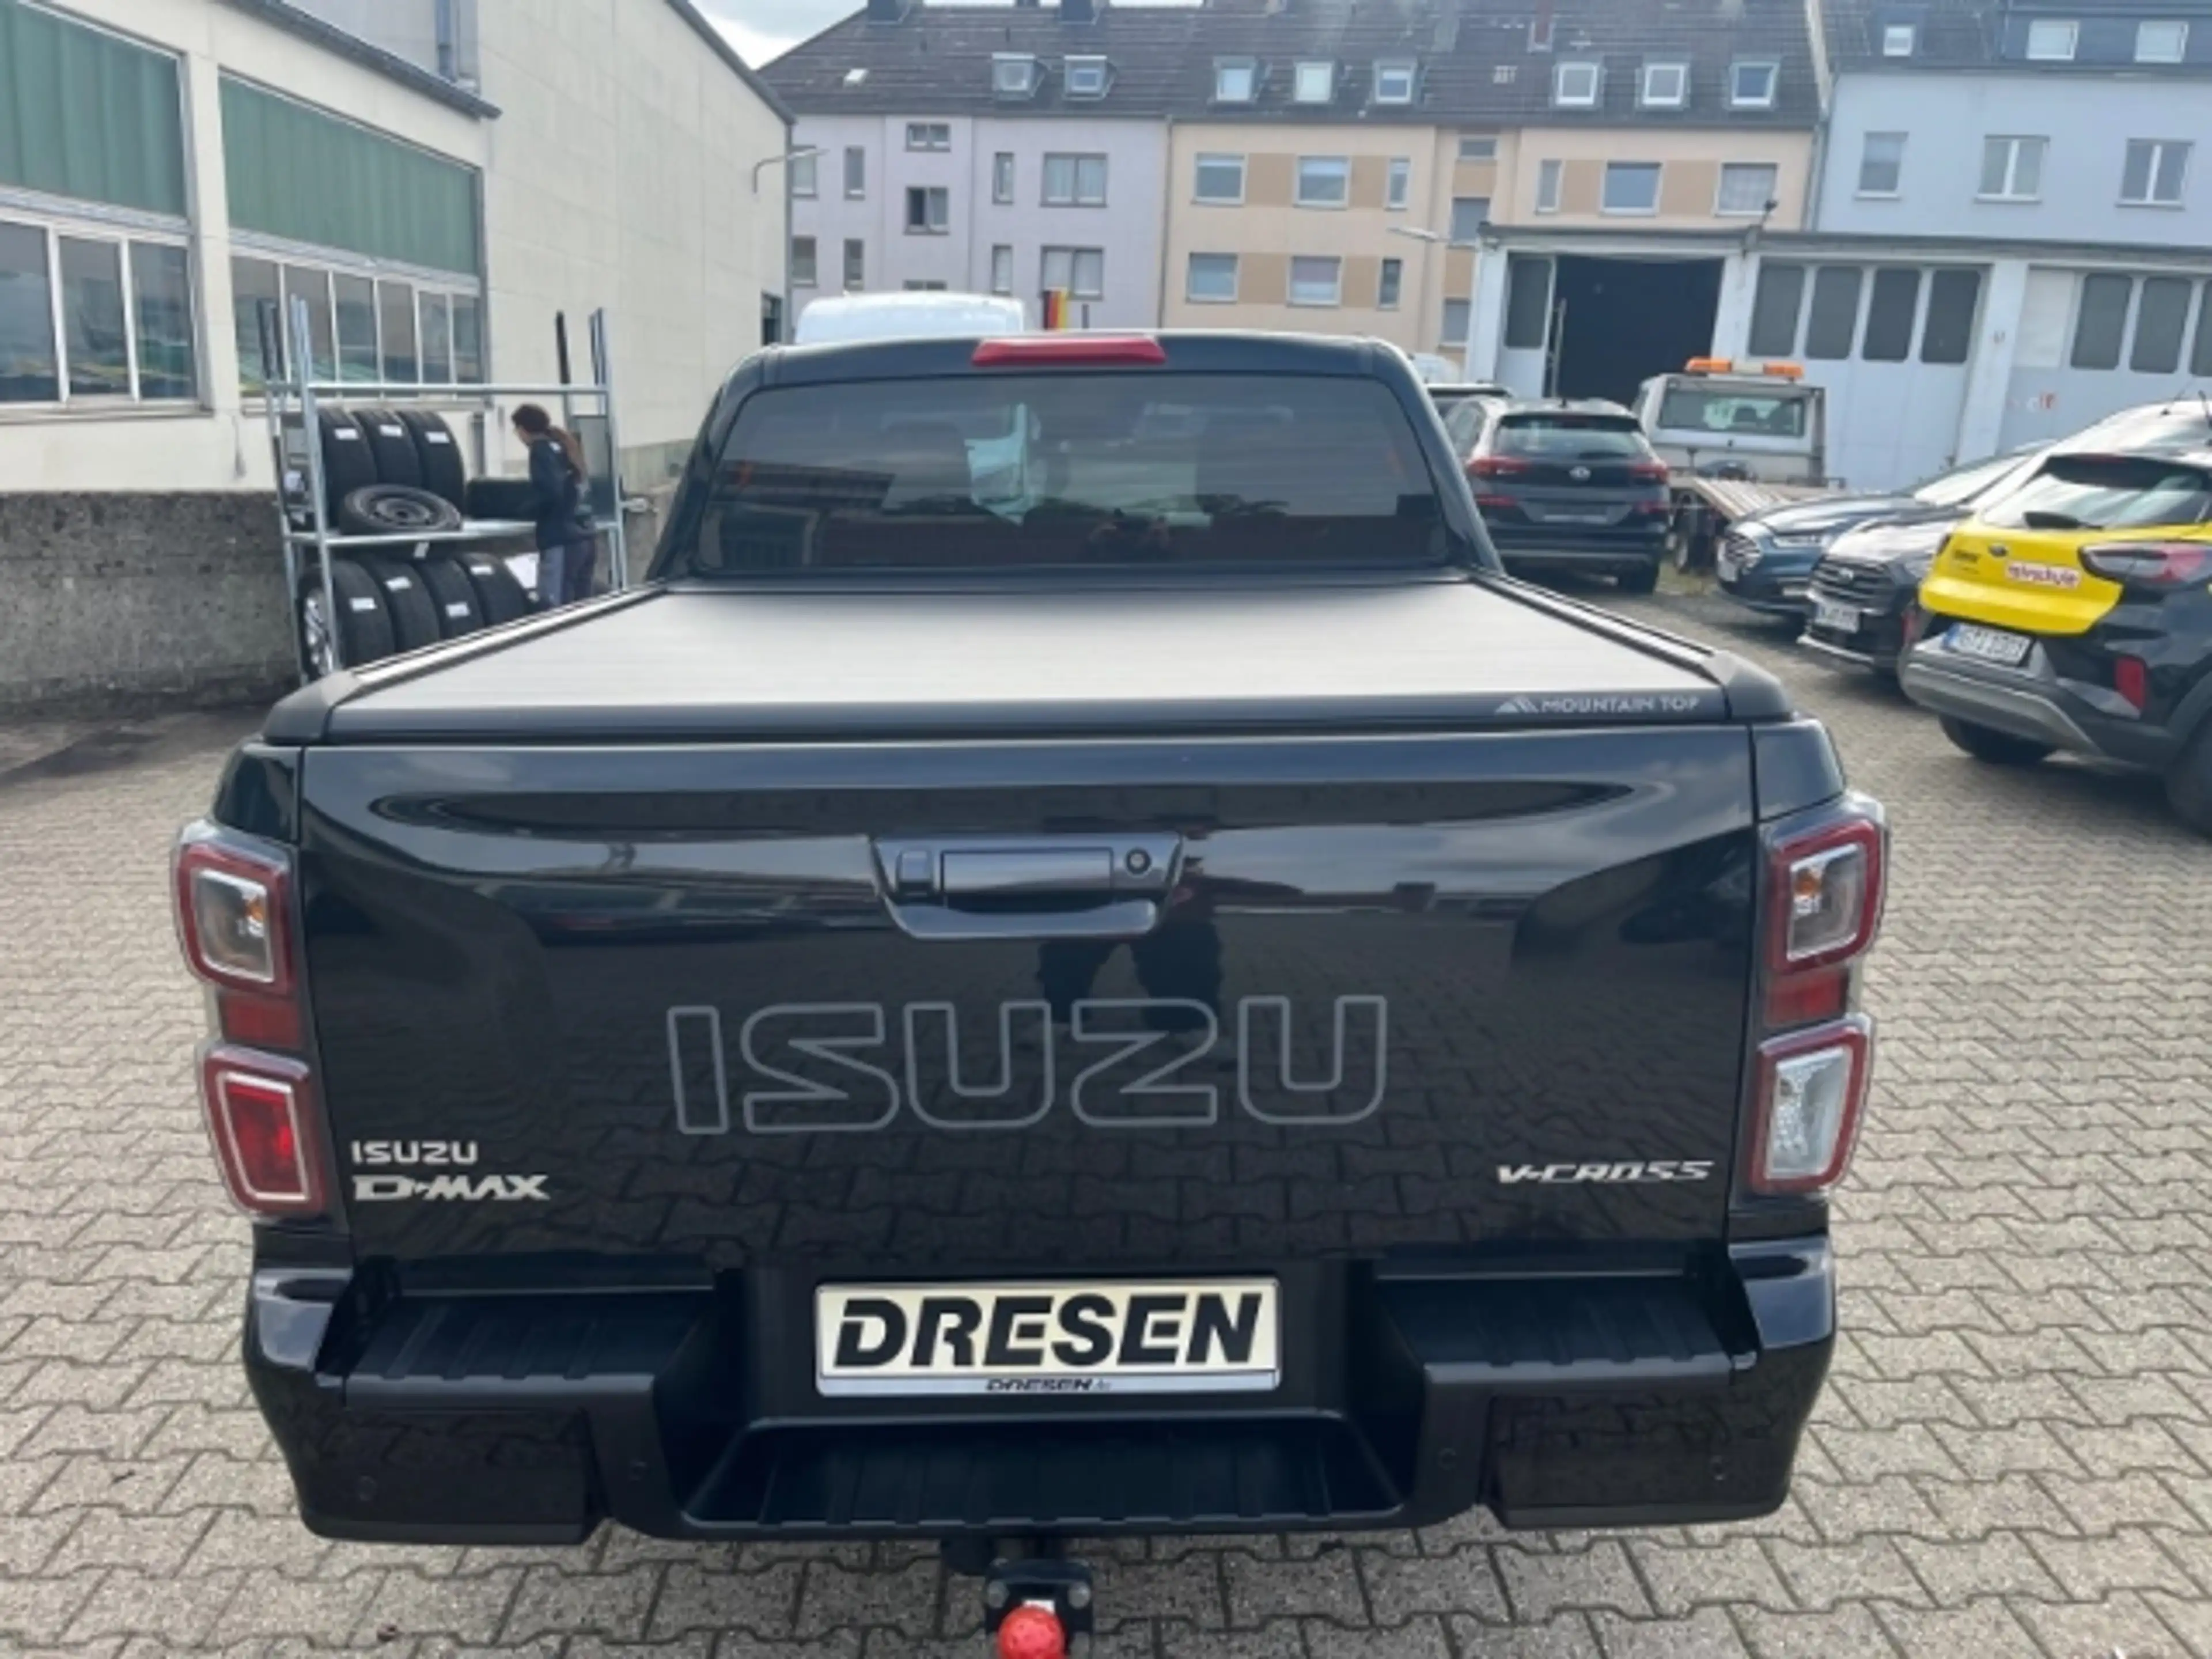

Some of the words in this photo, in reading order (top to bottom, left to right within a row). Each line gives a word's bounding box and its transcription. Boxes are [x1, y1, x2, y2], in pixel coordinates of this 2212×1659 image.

[1541, 696, 1654, 714] MOUNTAIN
[667, 995, 1387, 1134] ISUZU
[351, 1140, 478, 1165] ISUZU
[1497, 1160, 1714, 1183] V-CROSS
[352, 1175, 550, 1201] D-MAX
[834, 1293, 1263, 1368] DRESEN
